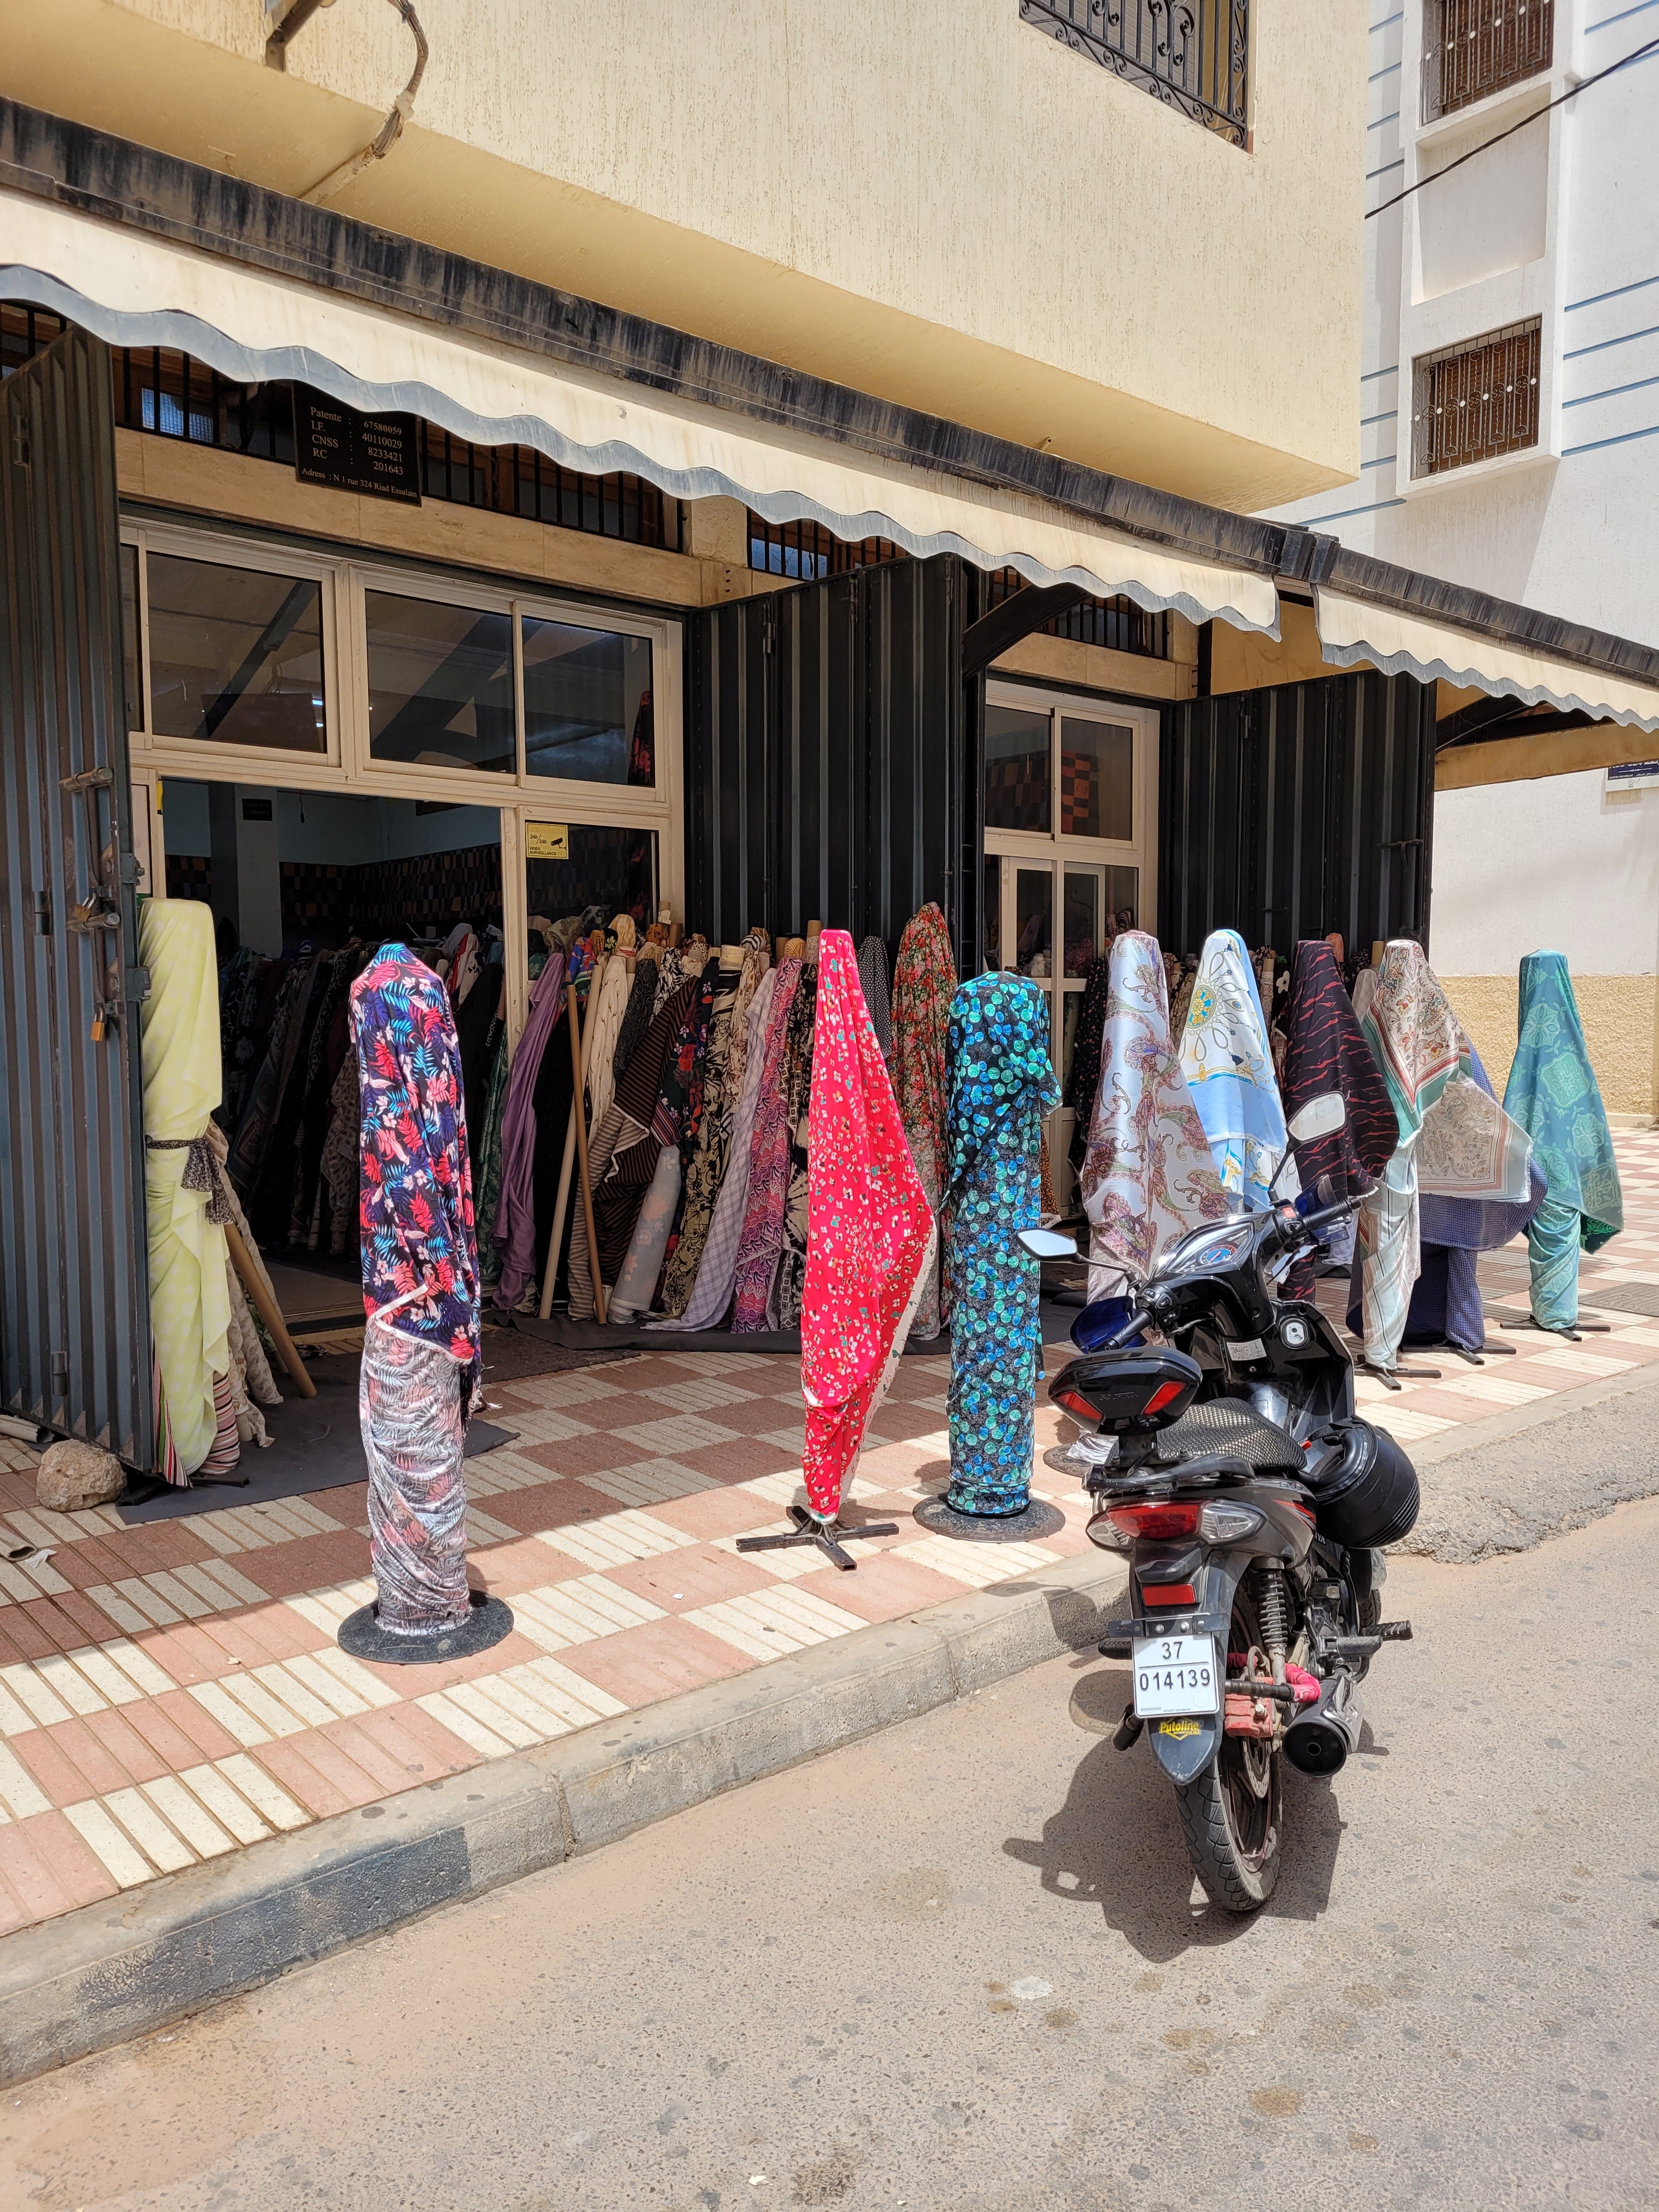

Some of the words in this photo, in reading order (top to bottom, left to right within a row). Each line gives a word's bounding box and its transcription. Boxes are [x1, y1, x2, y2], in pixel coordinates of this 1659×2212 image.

[310, 407, 342, 422] Patente
[364, 420, 402, 435] 67580059
[311, 421, 325, 432] I.F.
[362, 433, 402, 449] 40110029
[312, 435, 338, 448] CNSS
[368, 447, 403, 462] 8233421
[313, 448, 328, 459] RC
[373, 461, 403, 475] 201643
[302, 467, 325, 479] Adress
[360, 480, 372, 488] 324
[374, 483, 390, 493] Riad
[391, 487, 417, 498] Essalam
[1162, 1641, 1183, 1660] 37
[1139, 1668, 1210, 1691] 014139
[1159, 1720, 1199, 1733] Putoline
